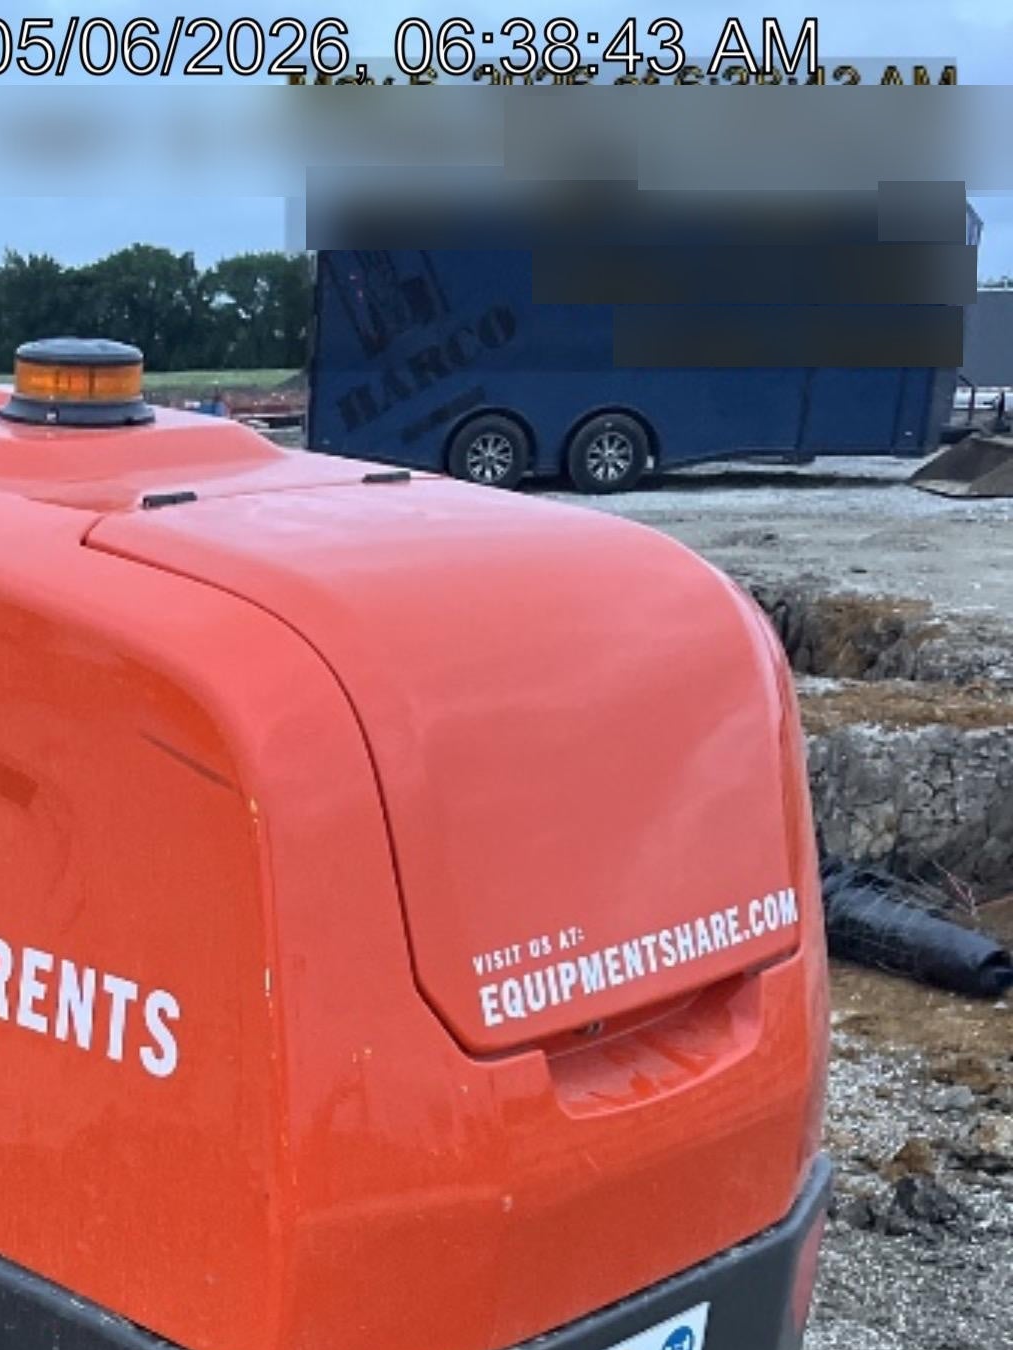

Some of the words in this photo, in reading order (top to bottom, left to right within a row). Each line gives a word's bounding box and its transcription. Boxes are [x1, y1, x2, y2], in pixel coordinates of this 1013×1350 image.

[473, 944, 521, 976] VISIT
[529, 935, 552, 959] US
[560, 925, 585, 950] AT:
[480, 887, 799, 1027] EQUIPMENTSHARE.COM
